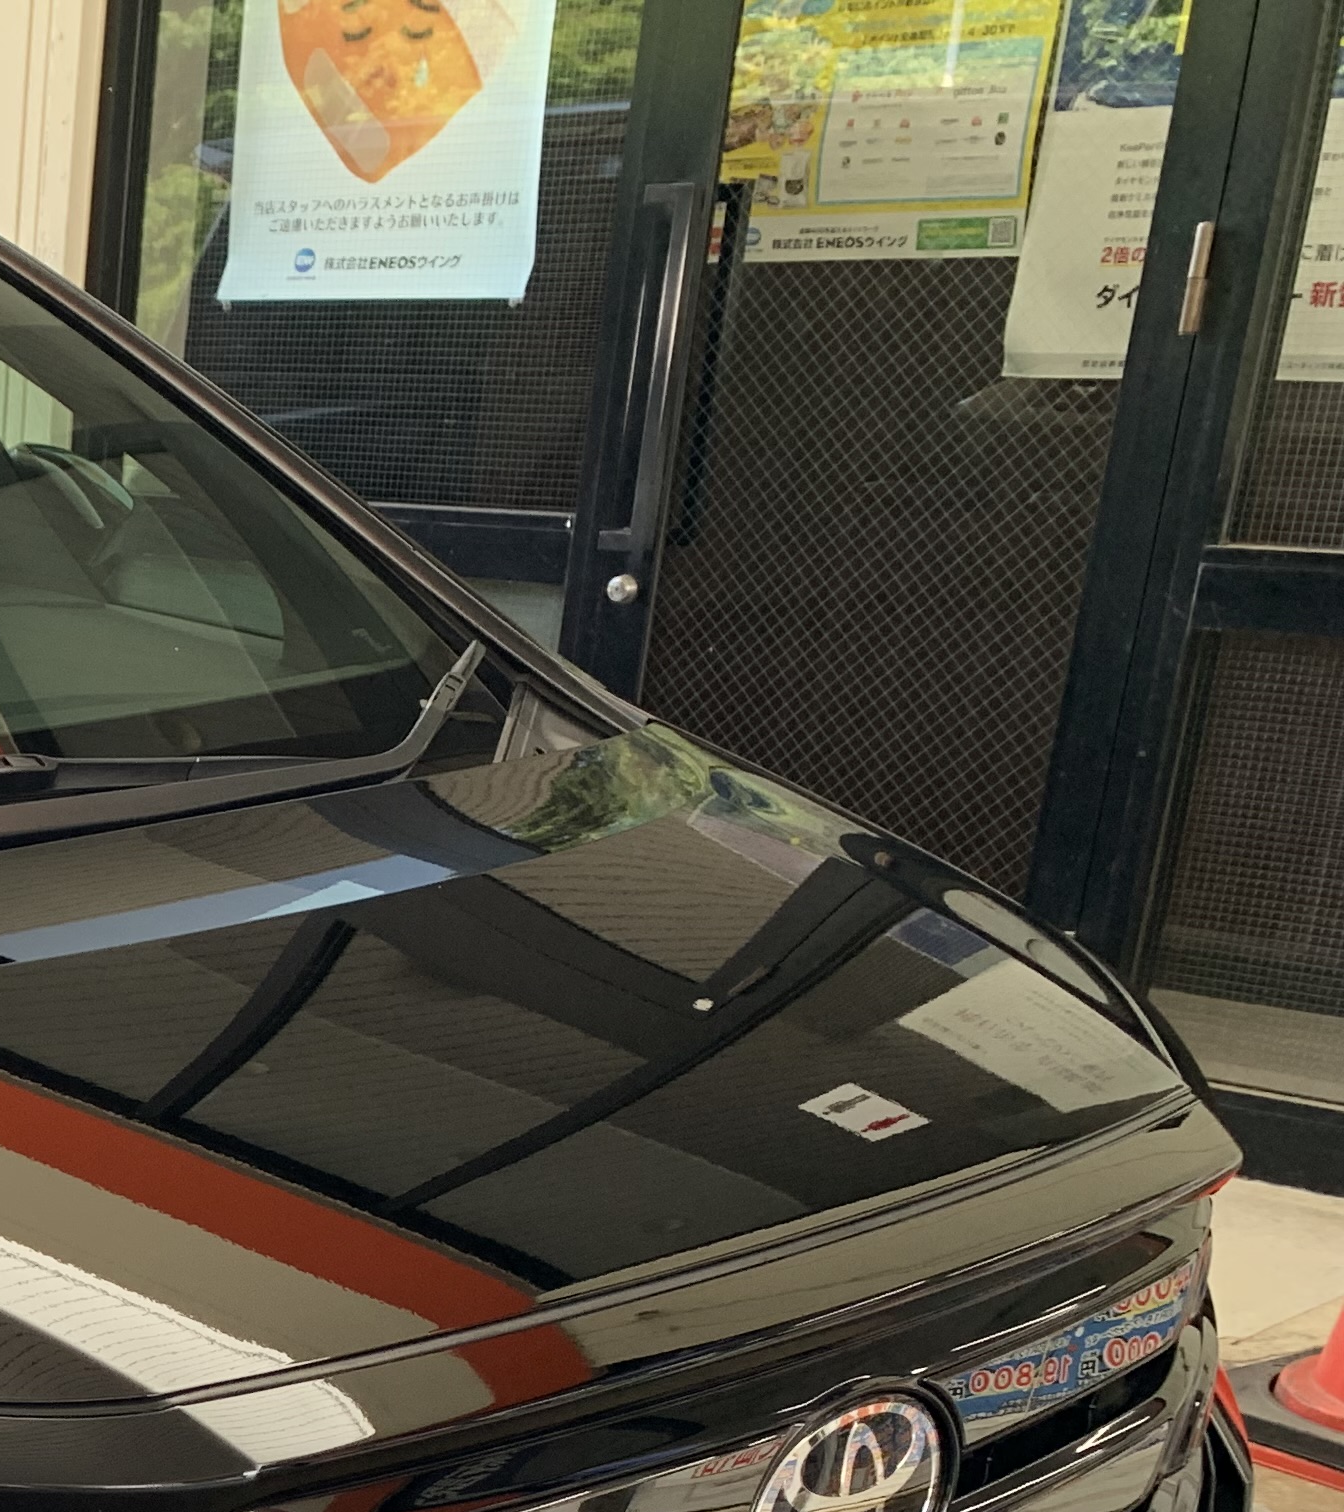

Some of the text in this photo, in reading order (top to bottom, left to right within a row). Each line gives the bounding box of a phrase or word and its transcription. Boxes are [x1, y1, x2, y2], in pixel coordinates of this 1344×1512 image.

[324, 255, 462, 271] 株式会社ENEOSウイング
